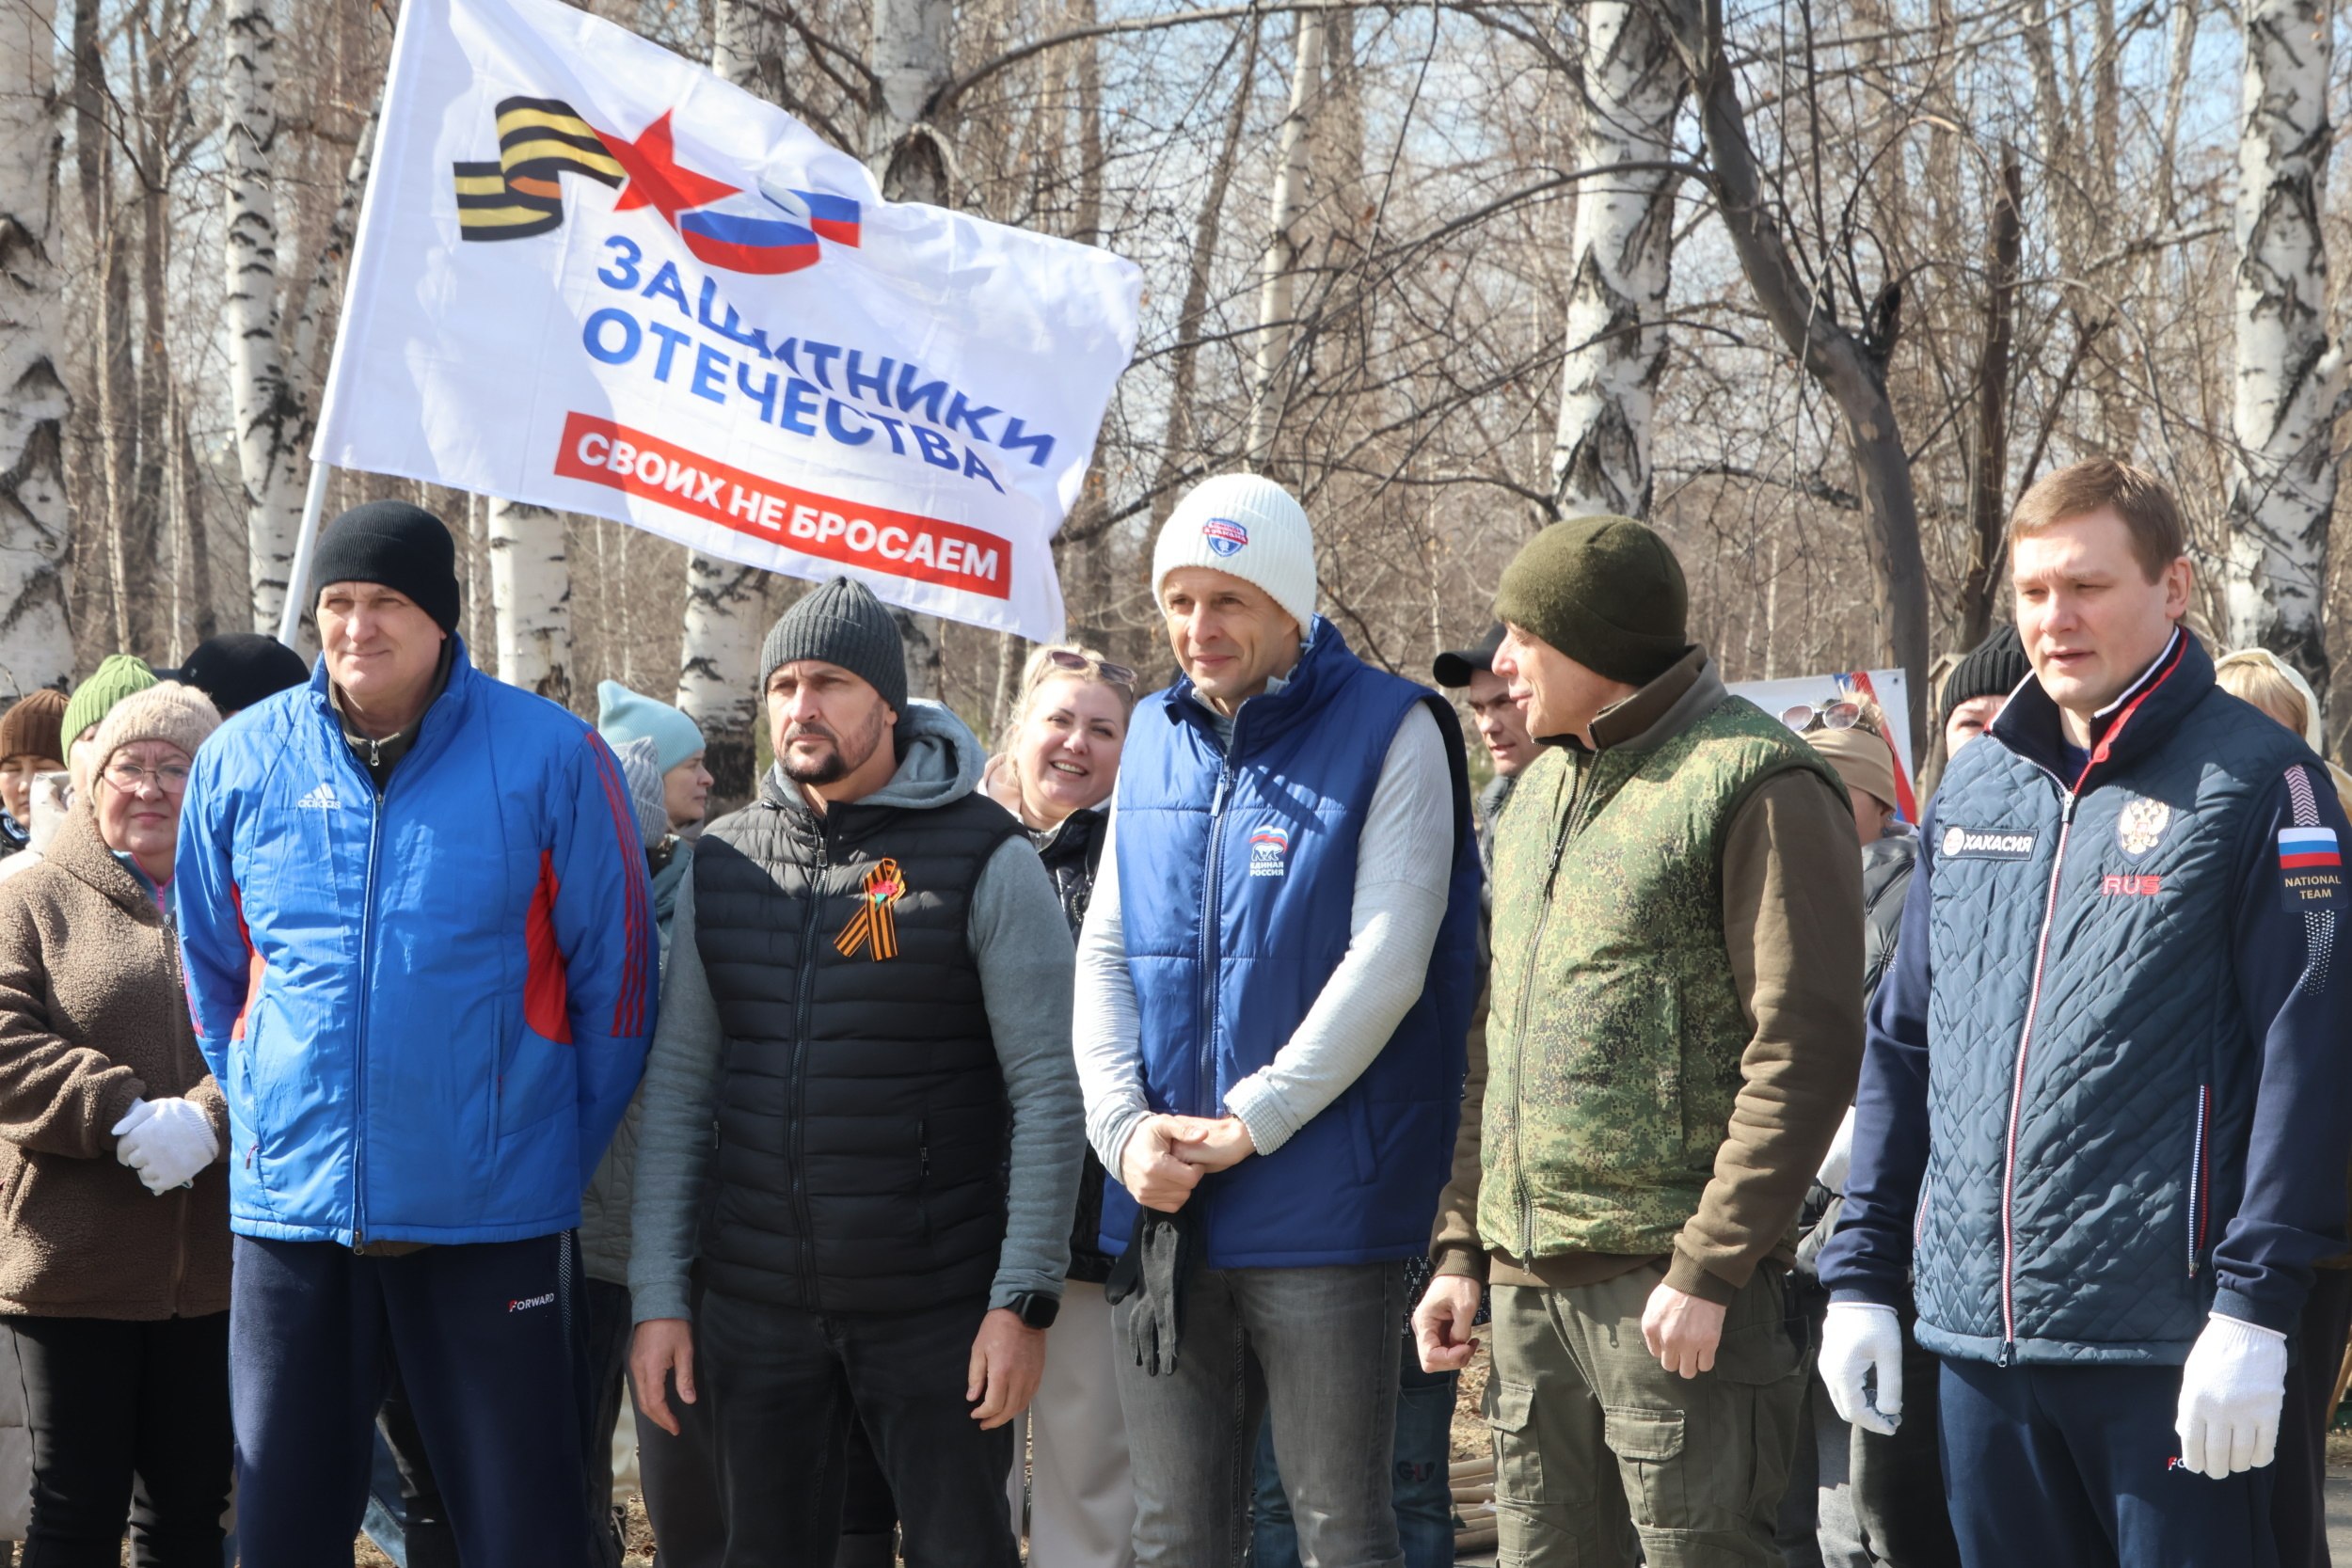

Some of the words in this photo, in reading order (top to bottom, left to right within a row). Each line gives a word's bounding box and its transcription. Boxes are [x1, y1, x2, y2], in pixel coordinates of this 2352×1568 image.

[582, 308, 1007, 496] ОТЕЧЕСТВА
[577, 432, 727, 510] СВОИХ
[727, 483, 787, 531] НЕ
[788, 503, 999, 582] БРОСАЕМ
[298, 799, 342, 809] adidas
[1963, 833, 2033, 853] ХАКАСИЯ
[2102, 875, 2161, 895] RUS
[2284, 875, 2342, 888] NATIONAL
[2299, 888, 2332, 900] TEAM
[509, 1292, 554, 1313] FORWARD
